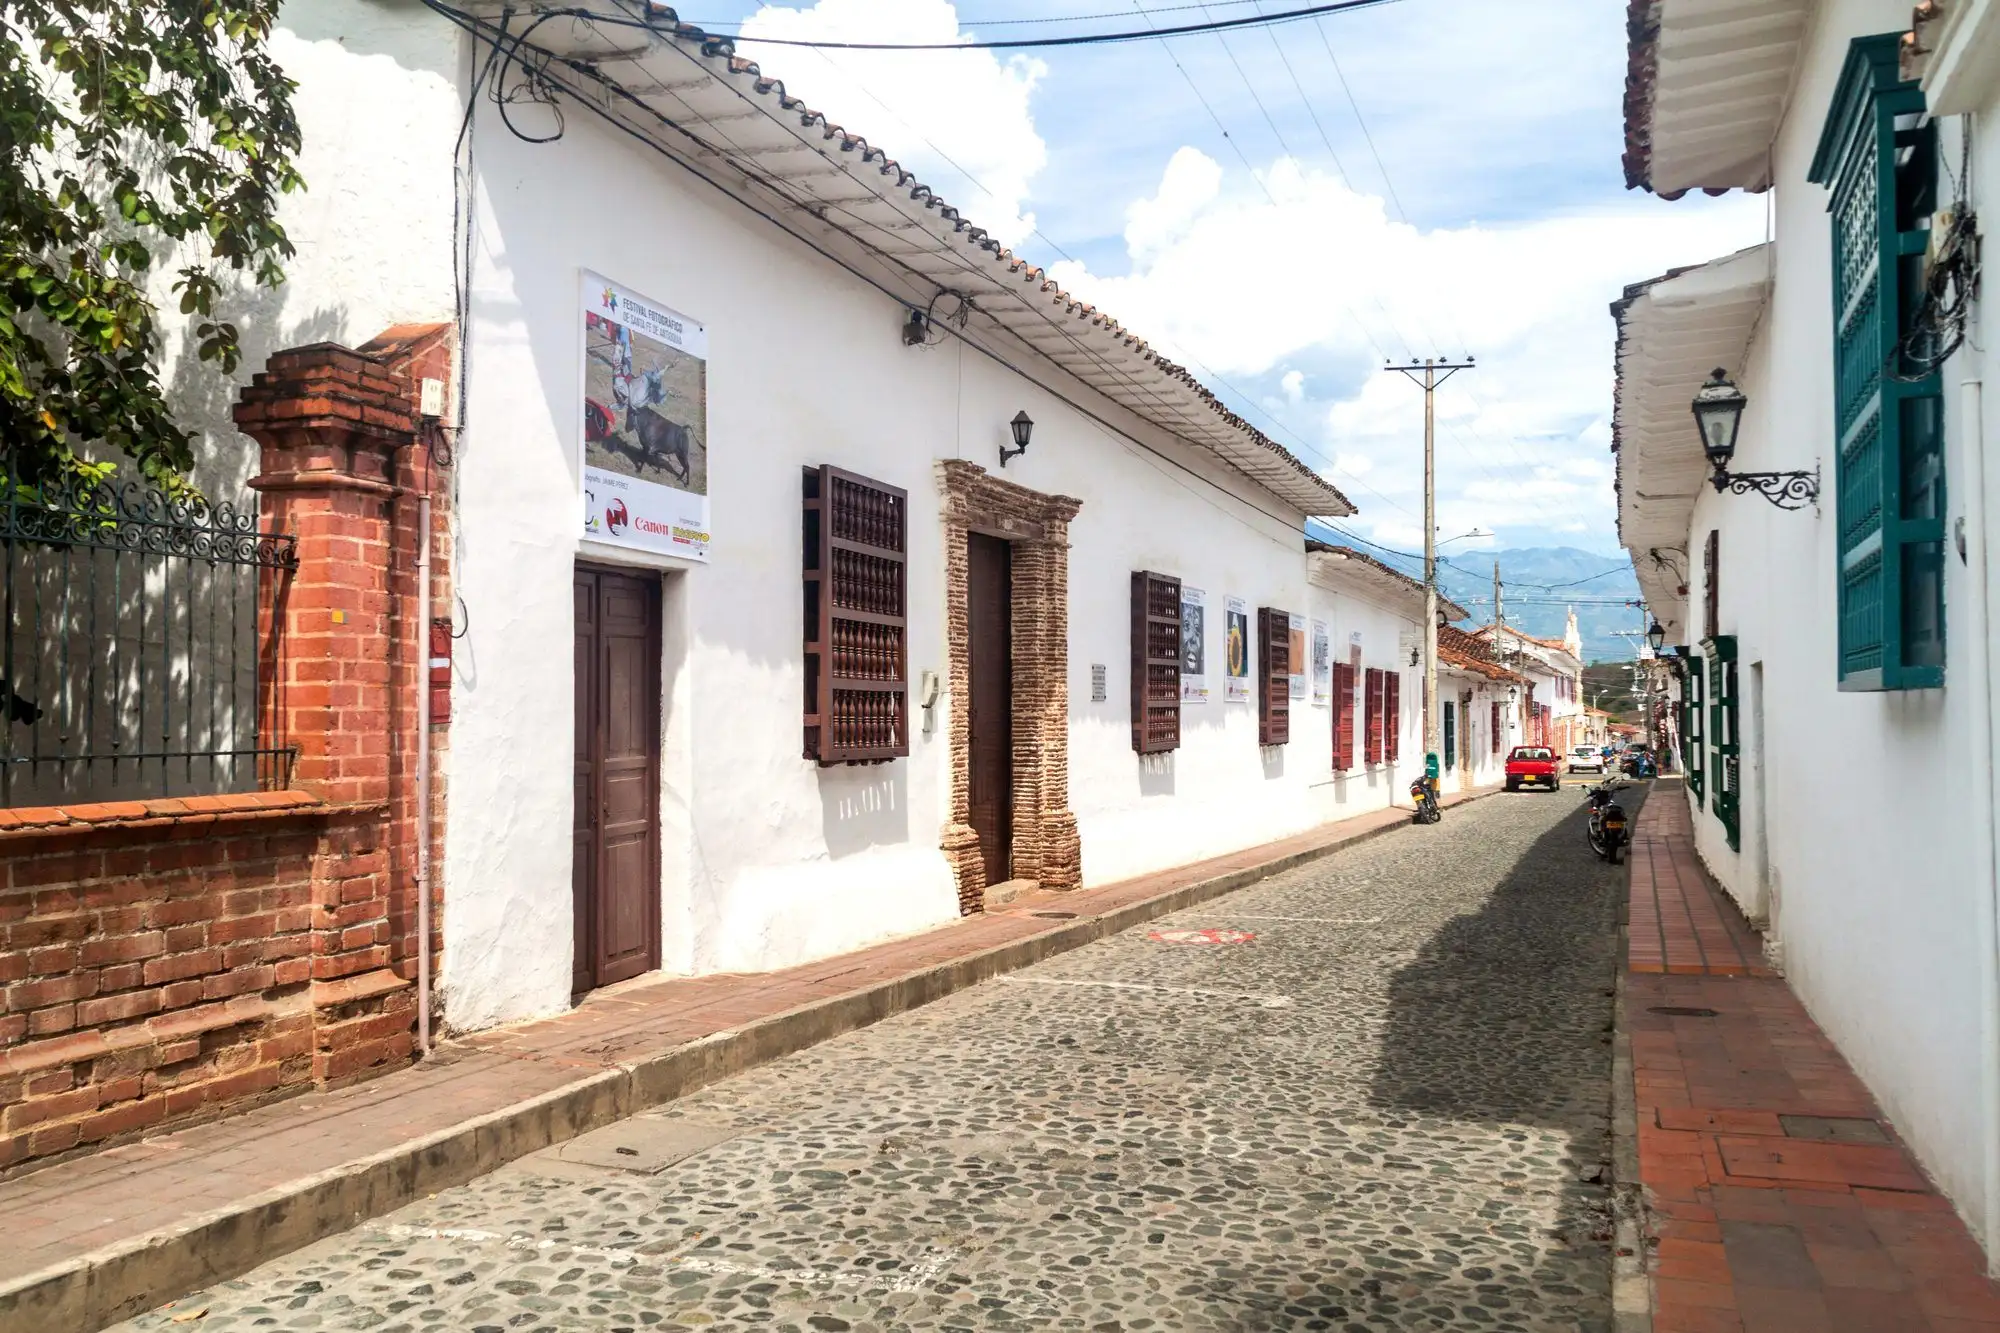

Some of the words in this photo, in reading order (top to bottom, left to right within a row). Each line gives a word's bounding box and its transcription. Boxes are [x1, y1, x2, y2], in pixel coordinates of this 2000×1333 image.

[623, 298, 647, 318] FESTIVAL
[623, 311, 630, 323] DE
[630, 314, 645, 329] SANTA
[634, 516, 669, 536] Canon
